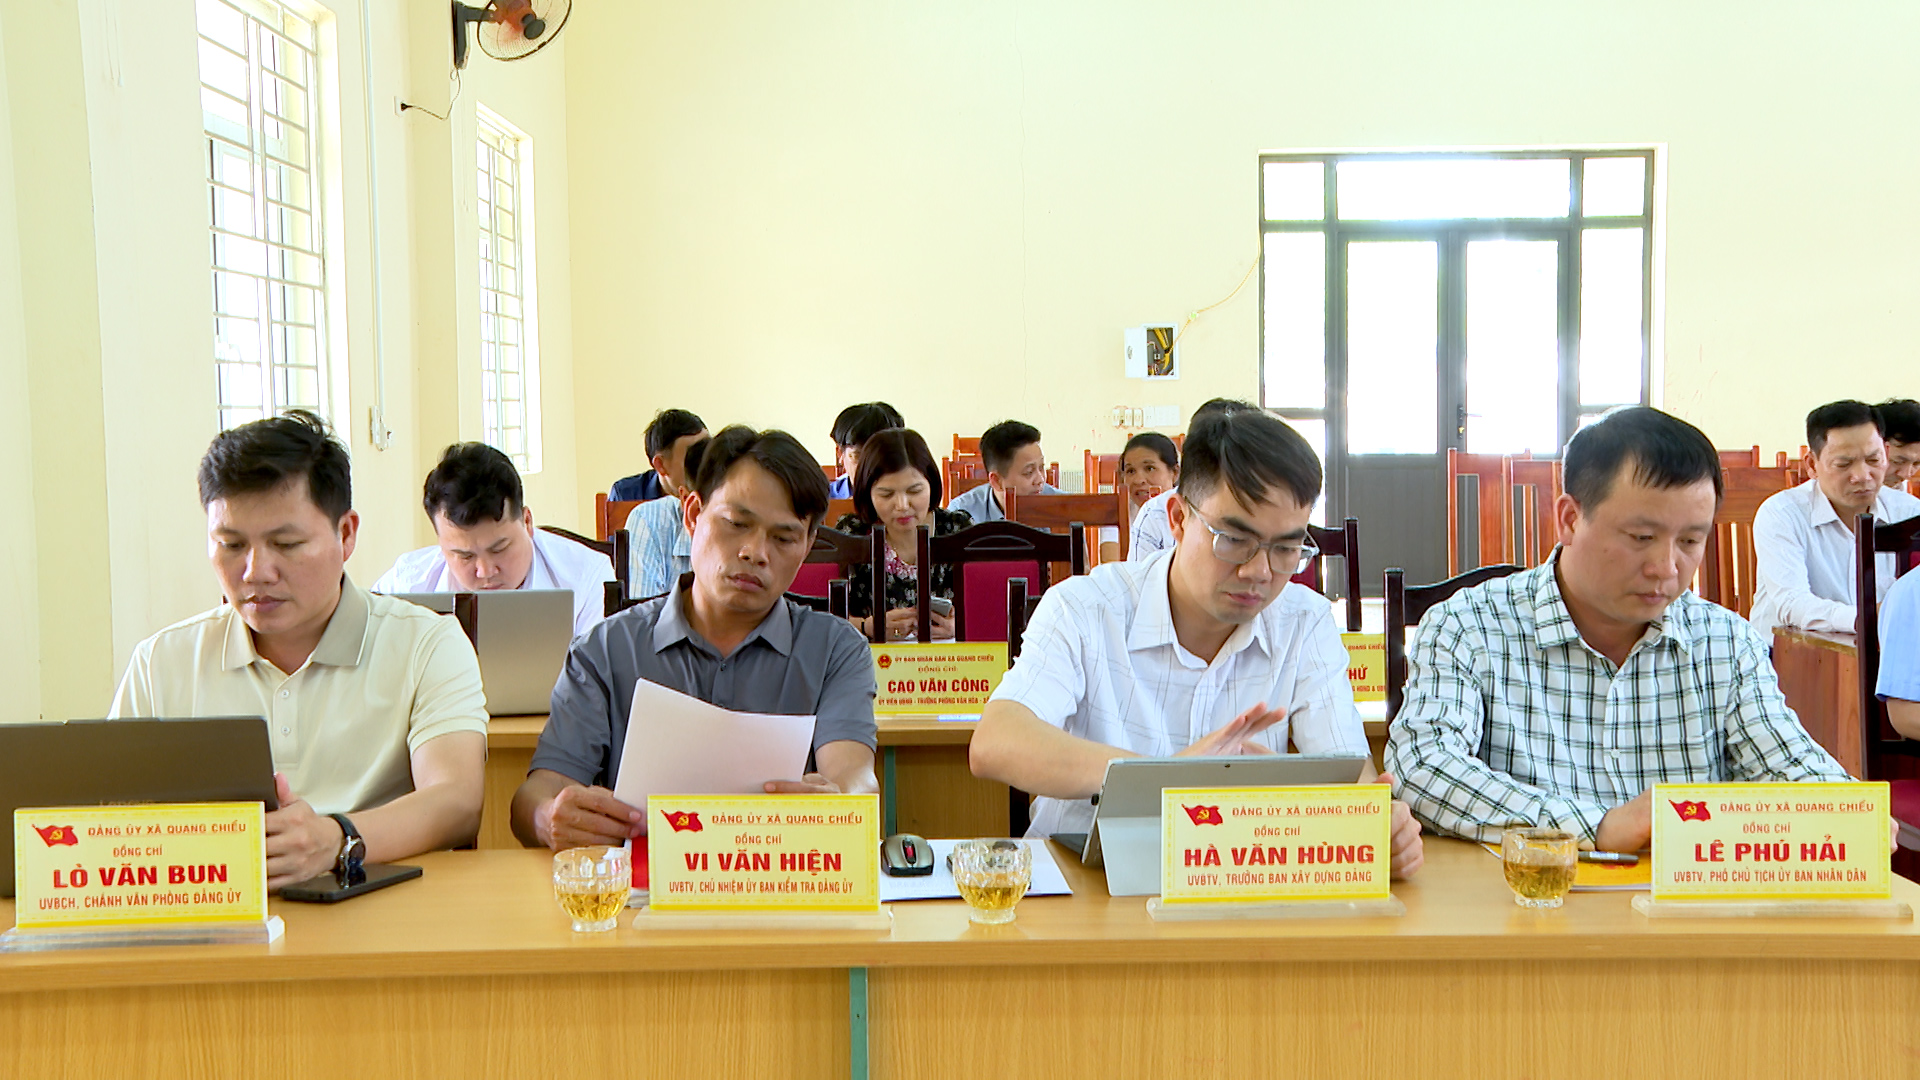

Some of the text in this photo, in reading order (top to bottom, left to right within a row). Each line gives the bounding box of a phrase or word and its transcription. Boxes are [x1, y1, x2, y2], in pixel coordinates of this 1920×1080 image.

[888, 676, 989, 693] CAO VĂN CÔNG
[1346, 664, 1368, 680] HỨ
[1184, 842, 1374, 867] HÀ VĂN HÙNG
[1695, 834, 1846, 862] LÊ PHÚ HẢI
[684, 849, 841, 875] VI VĂN HIỆN
[53, 862, 227, 888] LÒ VĂN BUN
